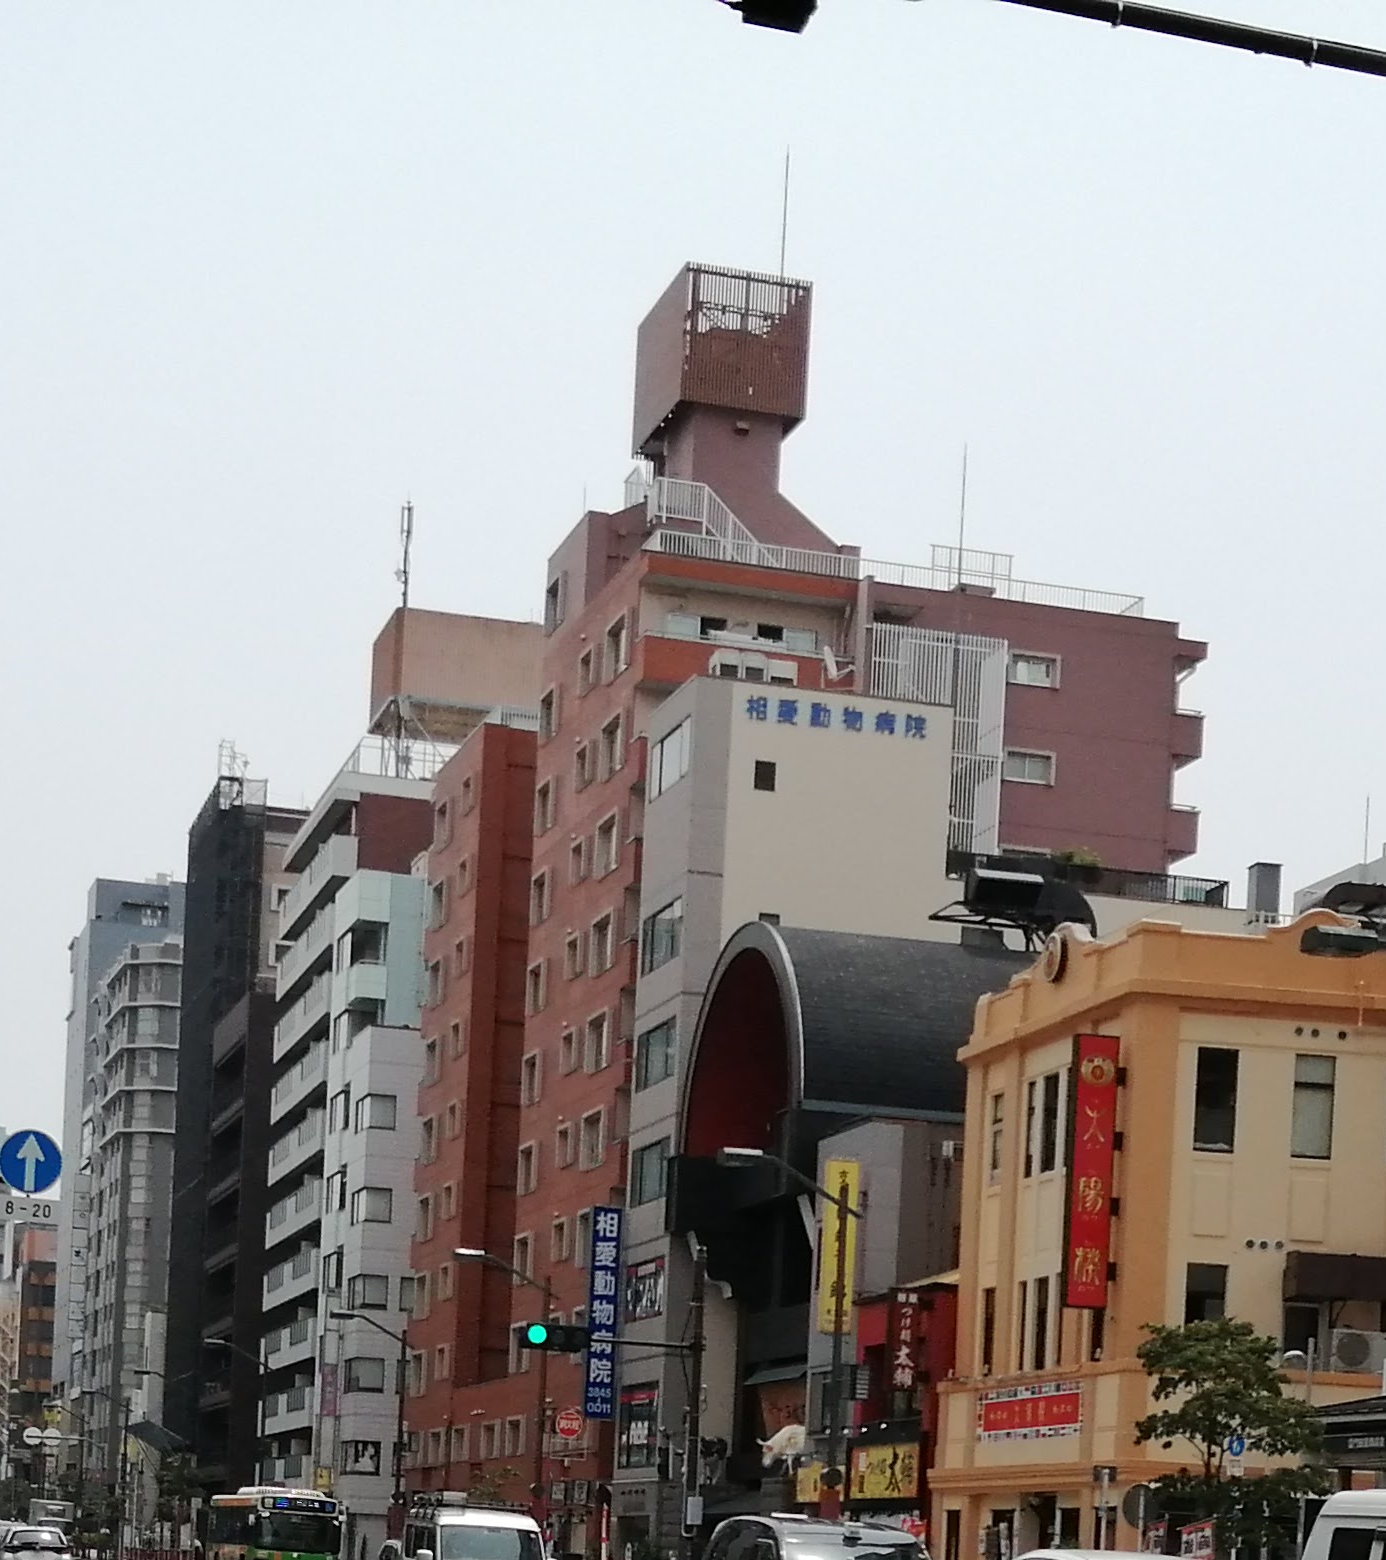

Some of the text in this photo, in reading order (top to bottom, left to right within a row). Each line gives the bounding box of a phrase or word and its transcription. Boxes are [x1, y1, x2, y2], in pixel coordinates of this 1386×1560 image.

[746, 695, 927, 740] 相愛動物病院
[588, 1211, 619, 1383] 相愛動物病院
